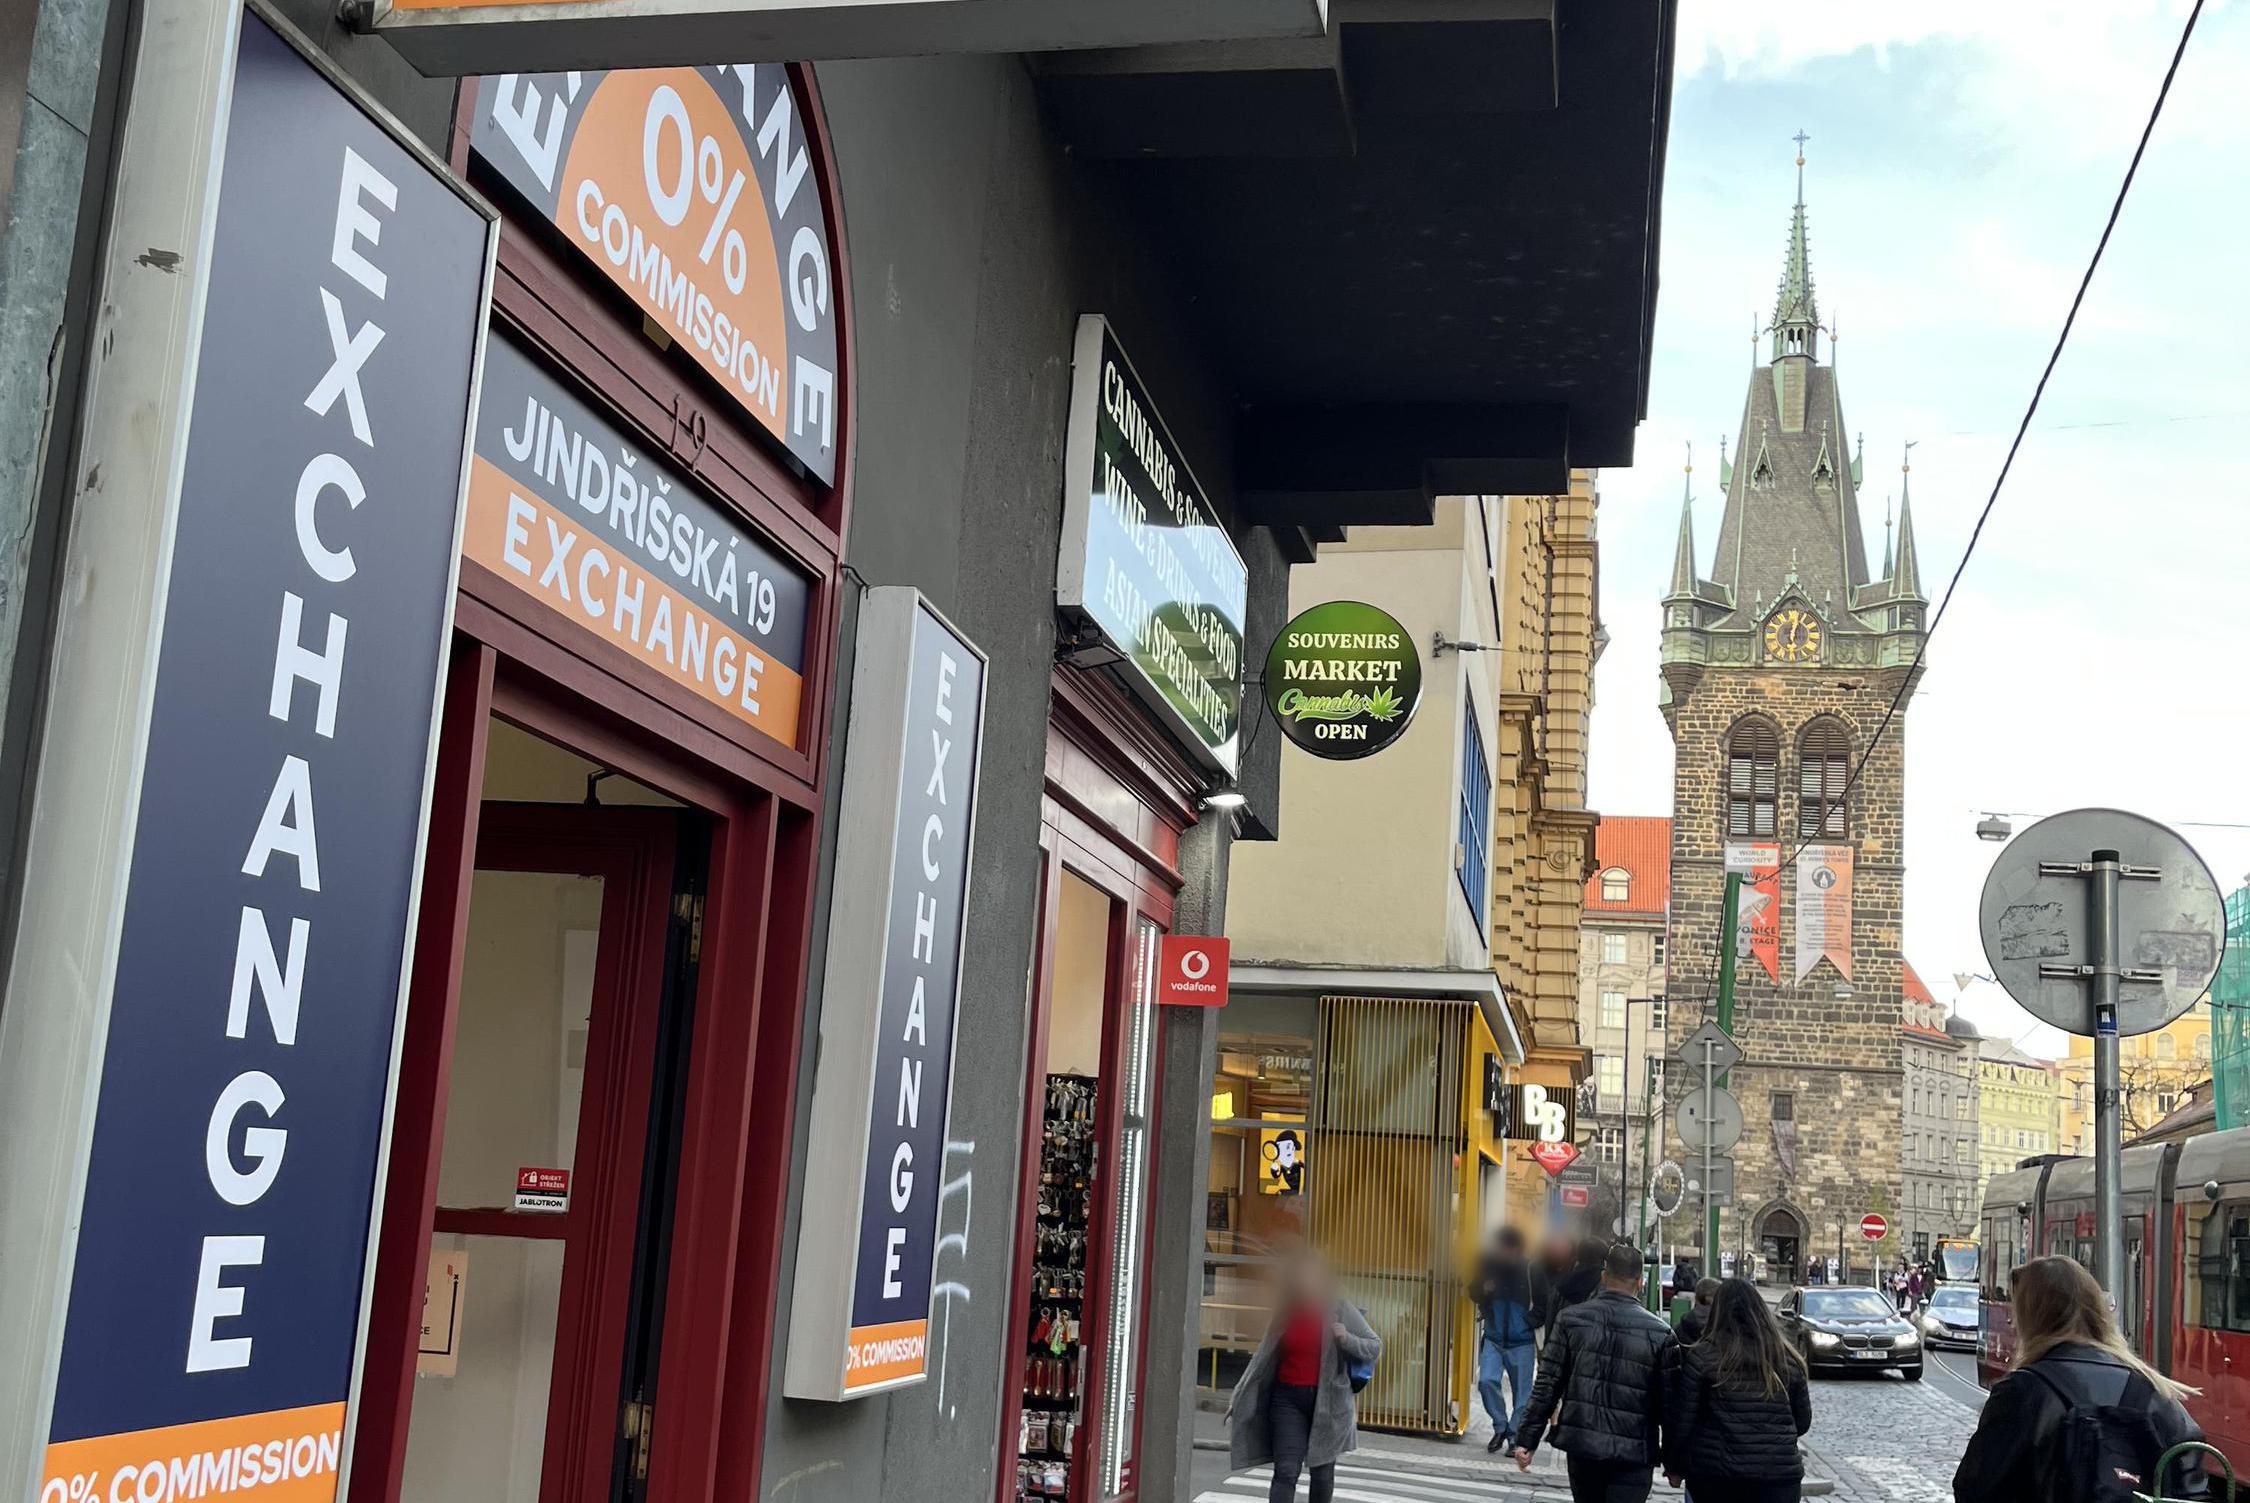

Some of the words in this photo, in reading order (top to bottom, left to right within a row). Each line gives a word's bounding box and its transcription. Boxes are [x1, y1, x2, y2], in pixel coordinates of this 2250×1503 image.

[643, 85, 747, 295] 0%
[576, 179, 780, 417] COMMISSION
[503, 396, 740, 615] JINDŘIŠSKÁ
[746, 570, 776, 635] 19
[1104, 361, 1176, 511] CANNABIS
[1175, 490, 1185, 525] &
[503, 491, 765, 716] EXCHANGE
[1104, 451, 1147, 555] WINE
[1146, 532, 1156, 567] &
[1156, 532, 1200, 633] DRINKS
[1200, 612, 1209, 645] &
[1209, 611, 1237, 682] FOOD
[1288, 632, 1400, 649] SOUVENIRS
[1104, 556, 1154, 653] ASIAN
[1152, 615, 1228, 744] SPECIALITIES
[1277, 687, 1367, 722] Cannabis
[1283, 659, 1402, 682] MARKET
[1314, 723, 1368, 740] OPEN
[186, 146, 399, 1374] EXCHANGE
[882, 650, 957, 1299] EXCHANGE
[1170, 981, 1217, 992] vodafone
[519, 1198, 563, 1207] JABLOTRON
[862, 1335, 926, 1367] COMMISSION
[109, 1430, 341, 1503] COMMISSION
